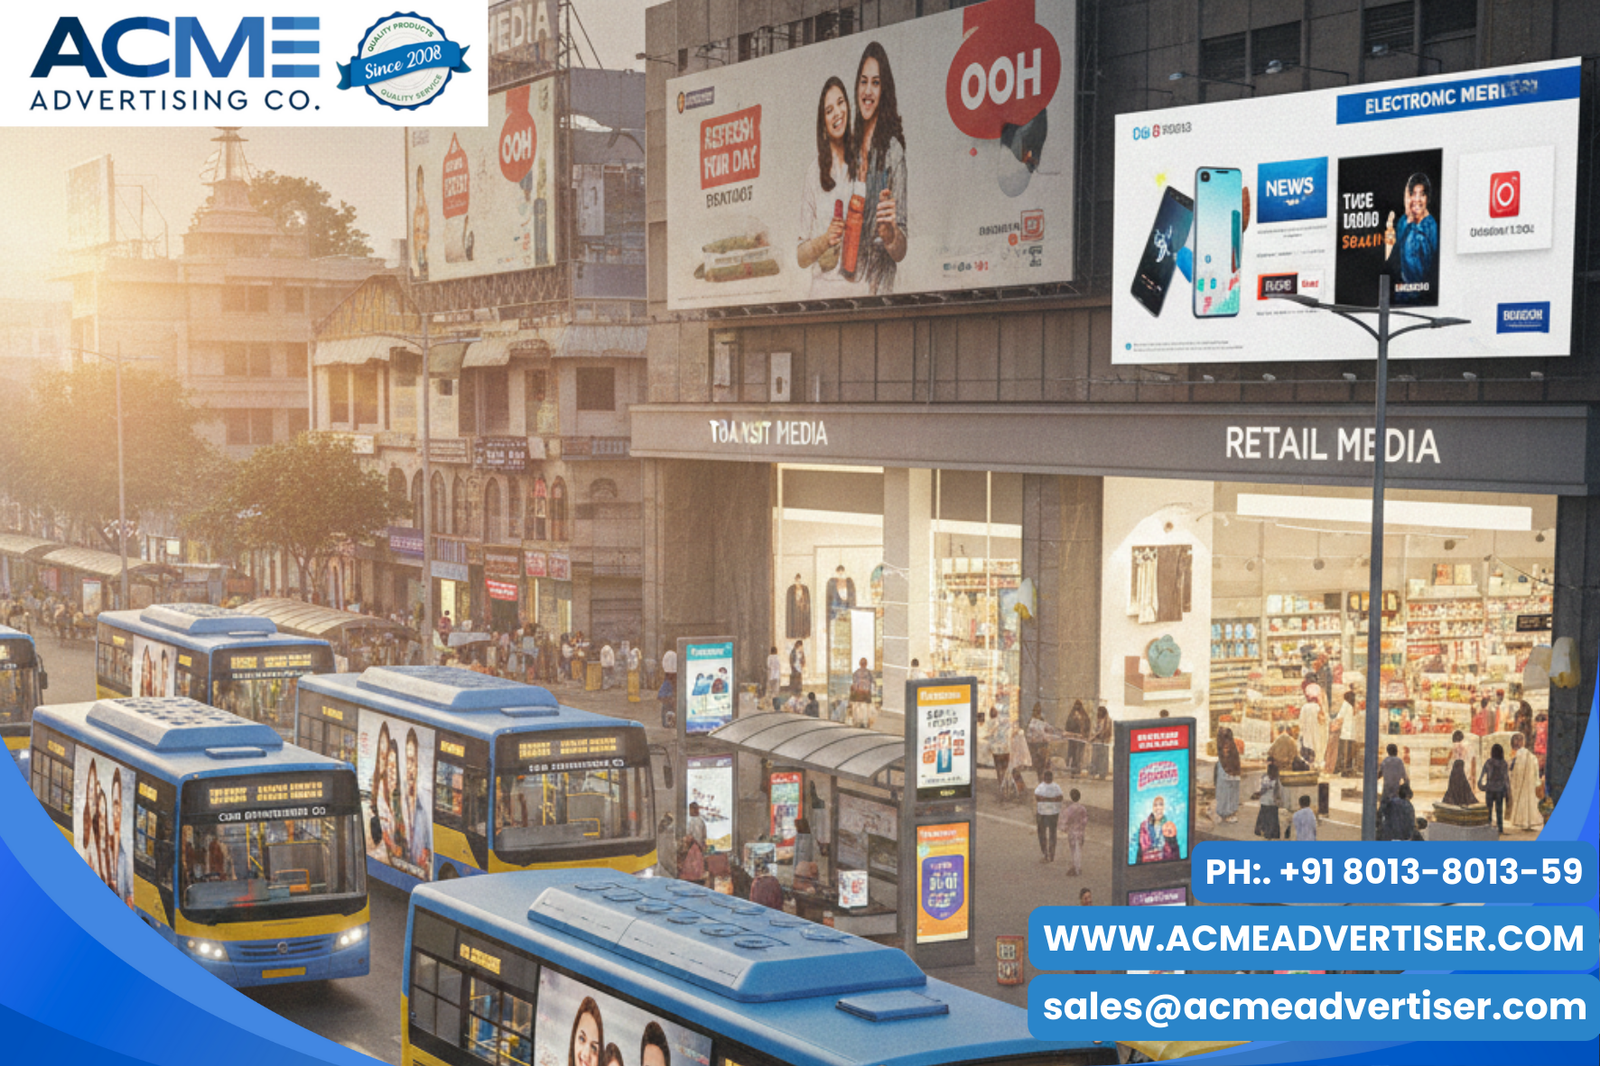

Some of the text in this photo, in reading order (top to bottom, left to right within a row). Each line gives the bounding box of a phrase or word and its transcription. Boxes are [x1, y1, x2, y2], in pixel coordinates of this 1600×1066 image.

[960, 47, 1043, 110] OOH
[502, 126, 532, 164] OOH
[733, 145, 758, 172] DAY
[1266, 177, 1314, 197] NEWS
[776, 420, 828, 445] MEDIA
[1226, 426, 1442, 464] RETAIL MEDIA
